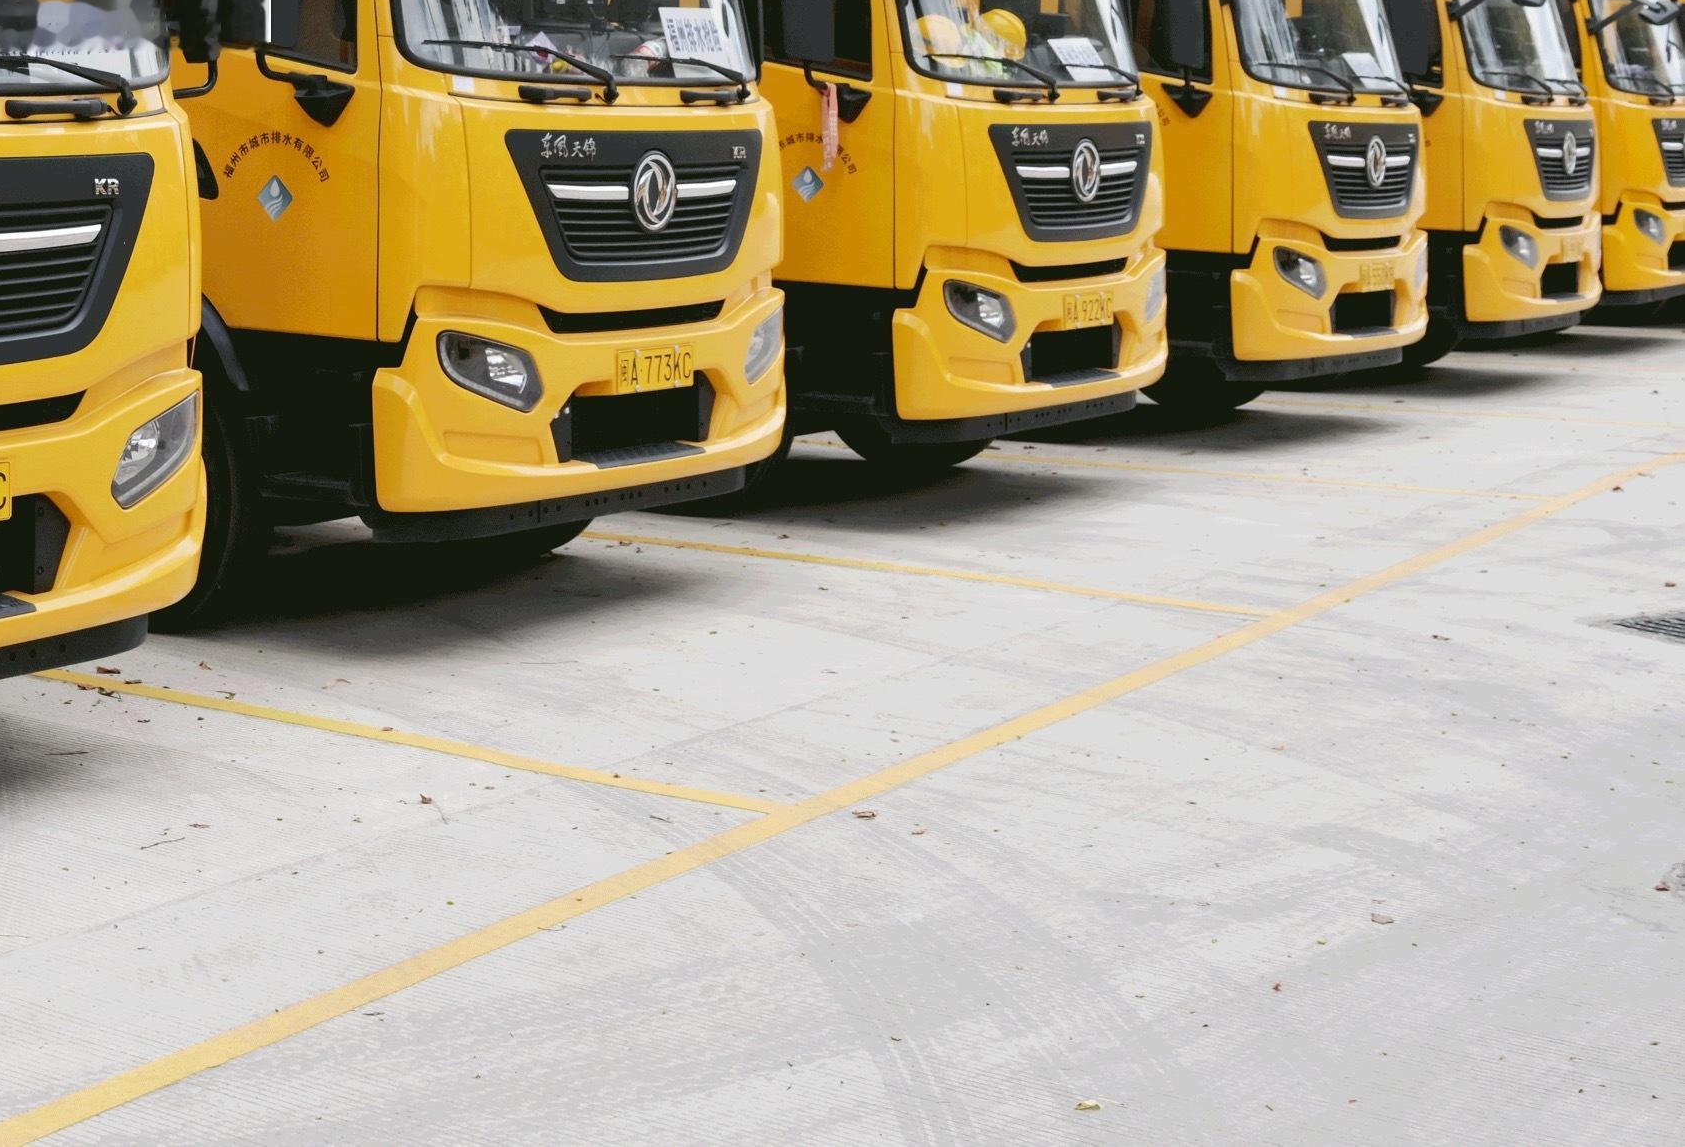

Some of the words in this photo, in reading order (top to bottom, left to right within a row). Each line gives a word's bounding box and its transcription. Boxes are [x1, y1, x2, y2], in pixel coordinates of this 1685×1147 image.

[223, 131, 330, 182] 福州市城市排水有限公司
[94, 178, 120, 195] KR
